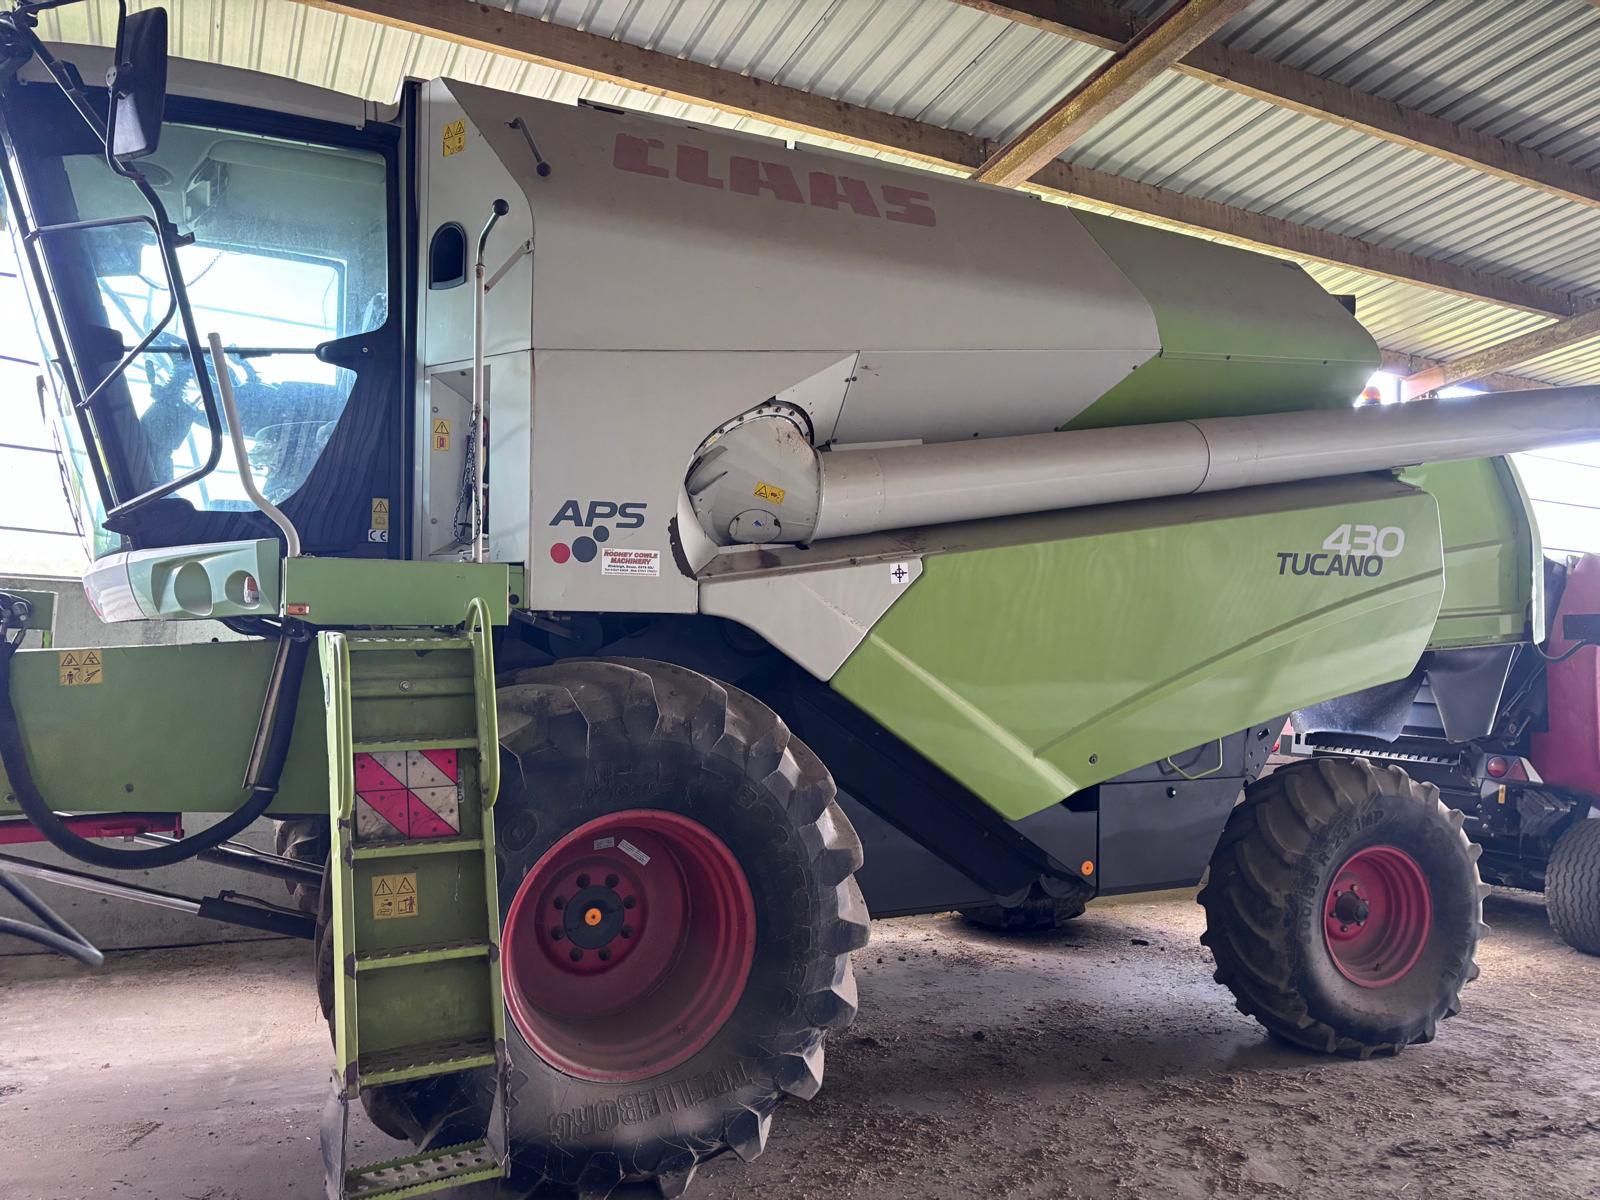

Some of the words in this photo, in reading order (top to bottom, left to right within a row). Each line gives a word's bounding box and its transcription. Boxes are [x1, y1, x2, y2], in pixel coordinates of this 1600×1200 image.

[612, 132, 937, 227] CLAAS
[549, 500, 647, 529] APS
[1322, 523, 1405, 558] 430
[1277, 552, 1384, 577] TUCANO
[551, 1061, 753, 1143] TRELLEBORG
